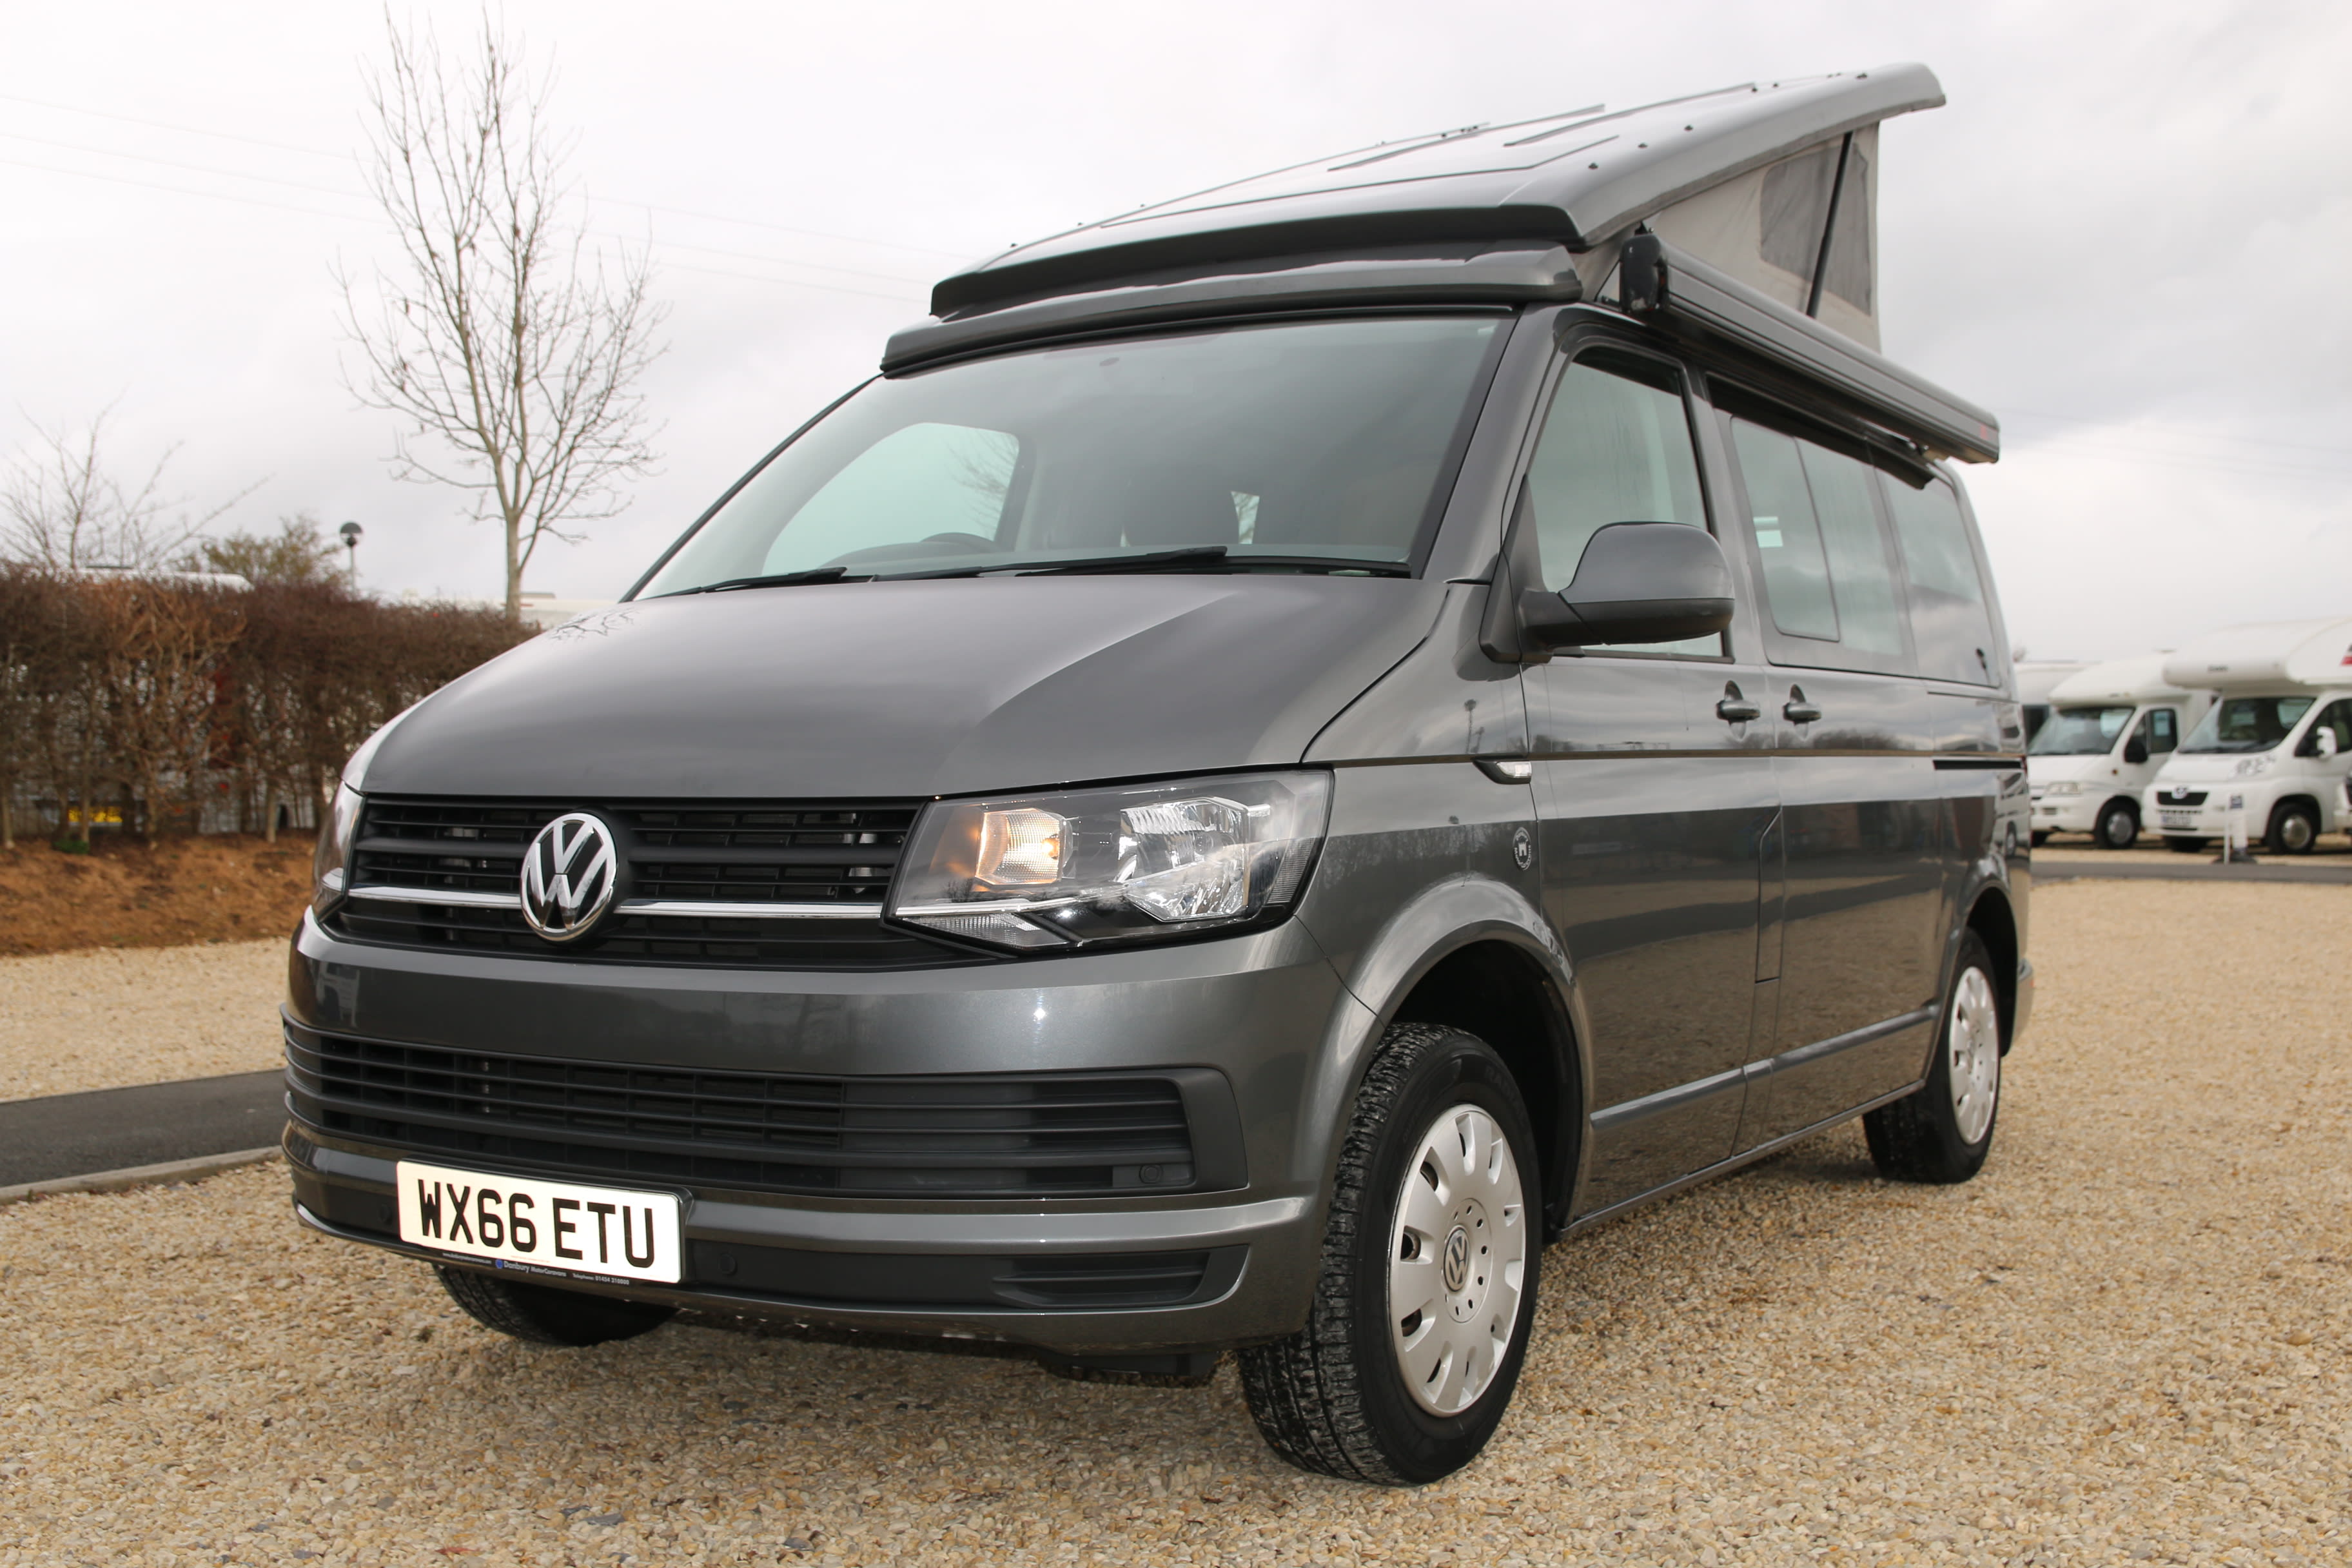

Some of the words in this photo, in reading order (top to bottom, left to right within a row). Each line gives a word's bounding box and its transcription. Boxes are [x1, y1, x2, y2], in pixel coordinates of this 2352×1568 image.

[418, 1179, 536, 1252] WX66
[553, 1197, 654, 1268] ETU
[504, 1260, 530, 1274] Danbury
